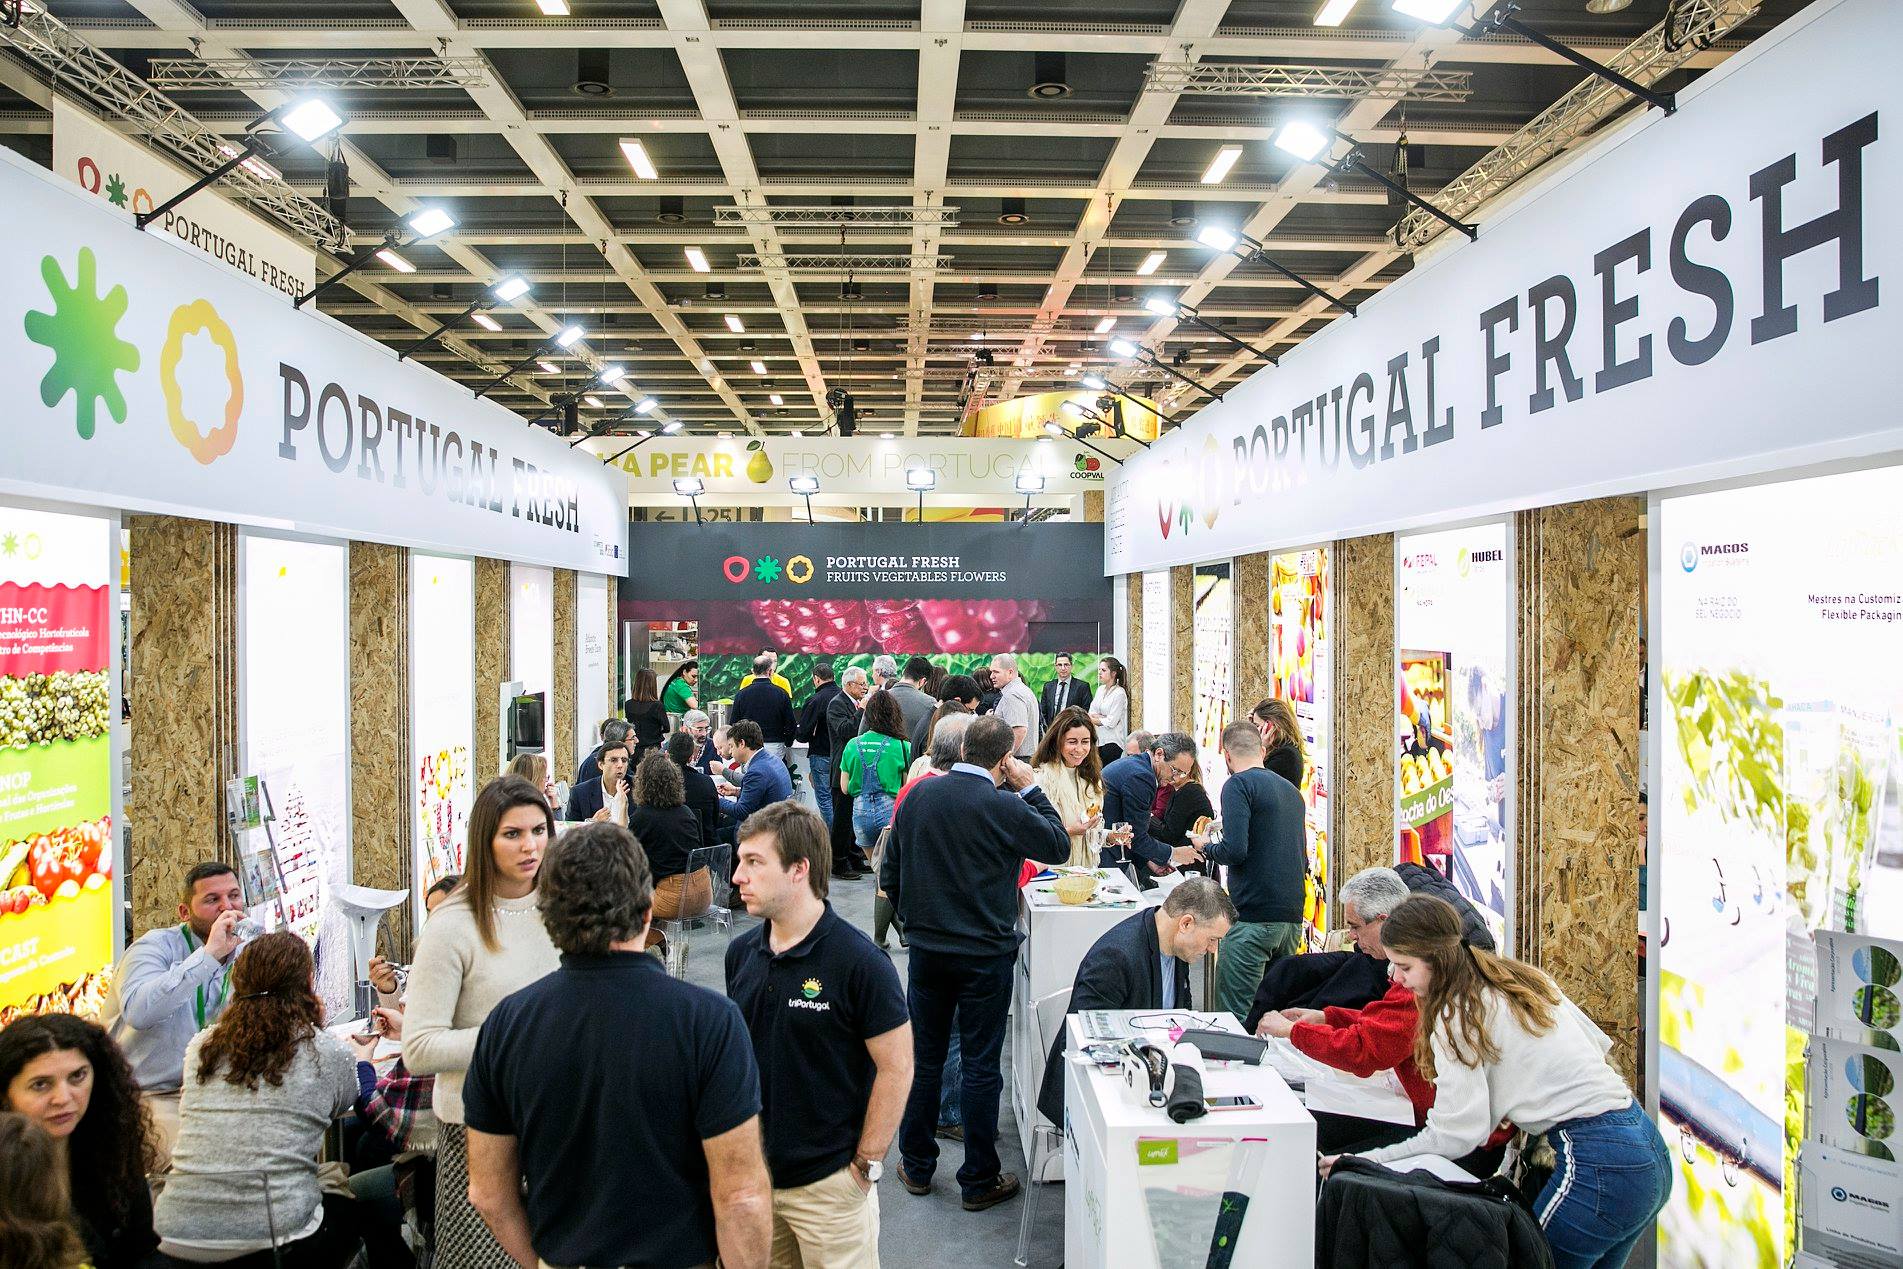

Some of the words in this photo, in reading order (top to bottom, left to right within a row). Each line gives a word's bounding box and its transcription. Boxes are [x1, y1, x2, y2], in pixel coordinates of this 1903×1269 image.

[164, 209, 256, 277] PORTUGAL
[261, 260, 305, 298] FRESH
[1233, 334, 1454, 506] PORTUGAL
[1480, 110, 1879, 430] FRESH
[279, 361, 503, 514] PORTUGAL
[512, 457, 579, 533] FRESH
[650, 452, 735, 477] PEAR
[782, 453, 872, 479] FROM
[884, 453, 1057, 479] PORTUGAL
[1701, 543, 1749, 555] MAGOS
[826, 556, 908, 569] PORTUGAL
[911, 556, 960, 569] FRESH
[1471, 550, 1503, 562] HUBEL
[826, 571, 870, 582] FRUITS
[873, 571, 948, 582] VEGETABLES
[951, 571, 1007, 582] FLOWERS
[1808, 593, 1842, 604] Mestres
[1844, 595, 1856, 604] na
[1822, 609, 1857, 620] Flexible
[1400, 800, 1425, 823] ocha
[1426, 793, 1437, 814] do
